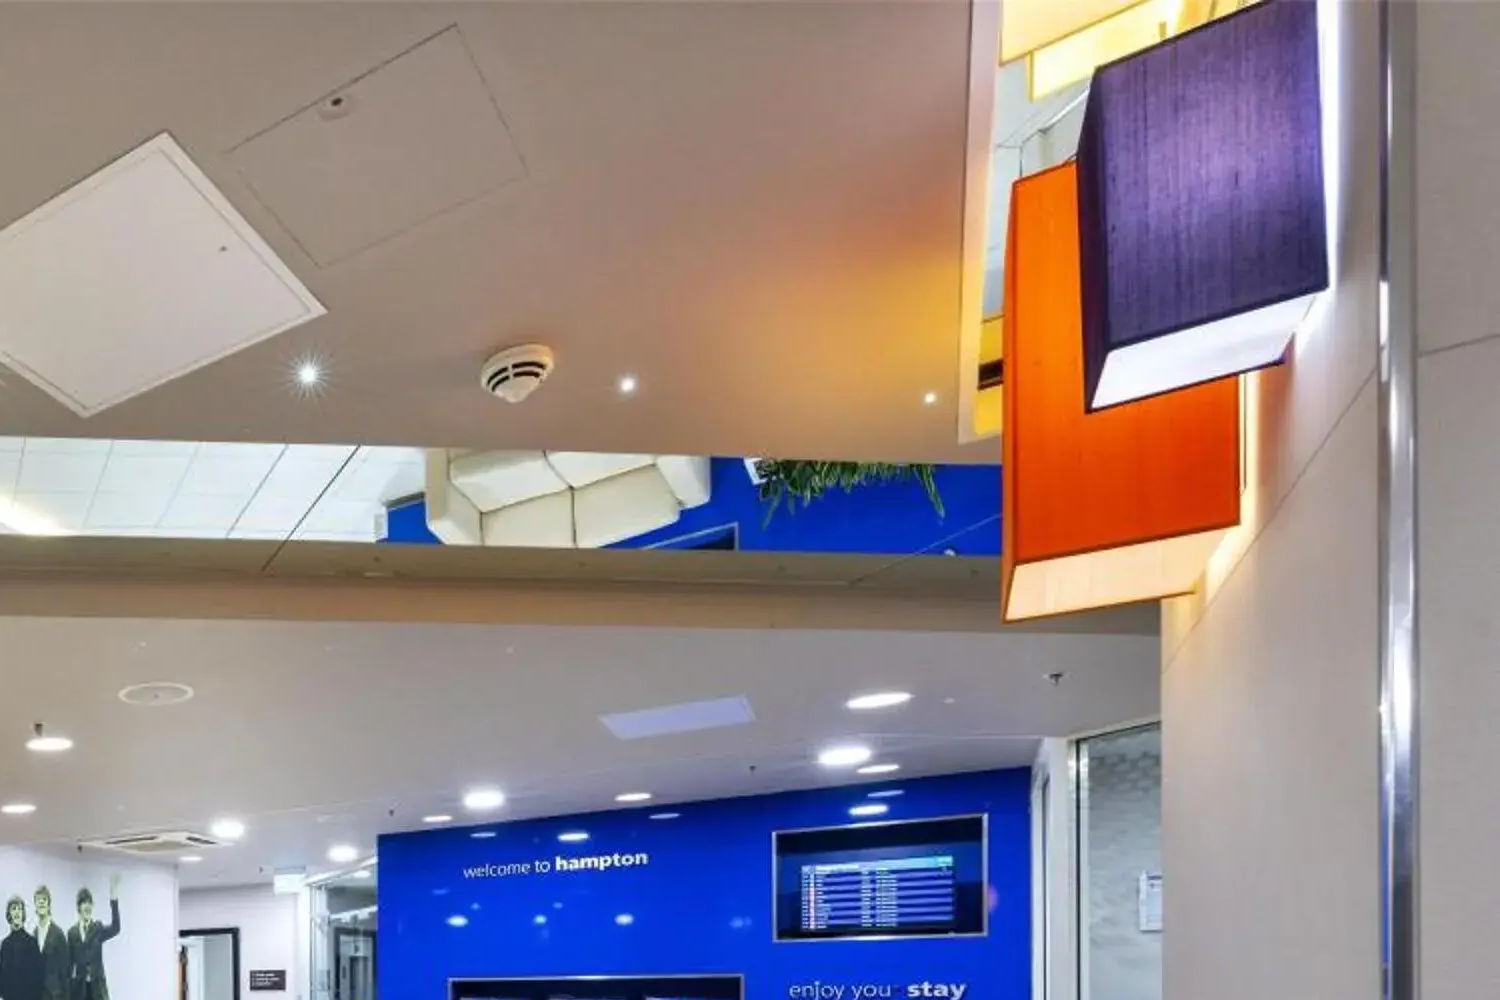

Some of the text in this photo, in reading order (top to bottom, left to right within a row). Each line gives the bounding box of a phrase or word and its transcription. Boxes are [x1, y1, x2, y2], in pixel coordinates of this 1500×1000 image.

[463, 852, 648, 879] welcome to hampton
[789, 981, 845, 1000] enjoy
[907, 981, 966, 1000] stay
